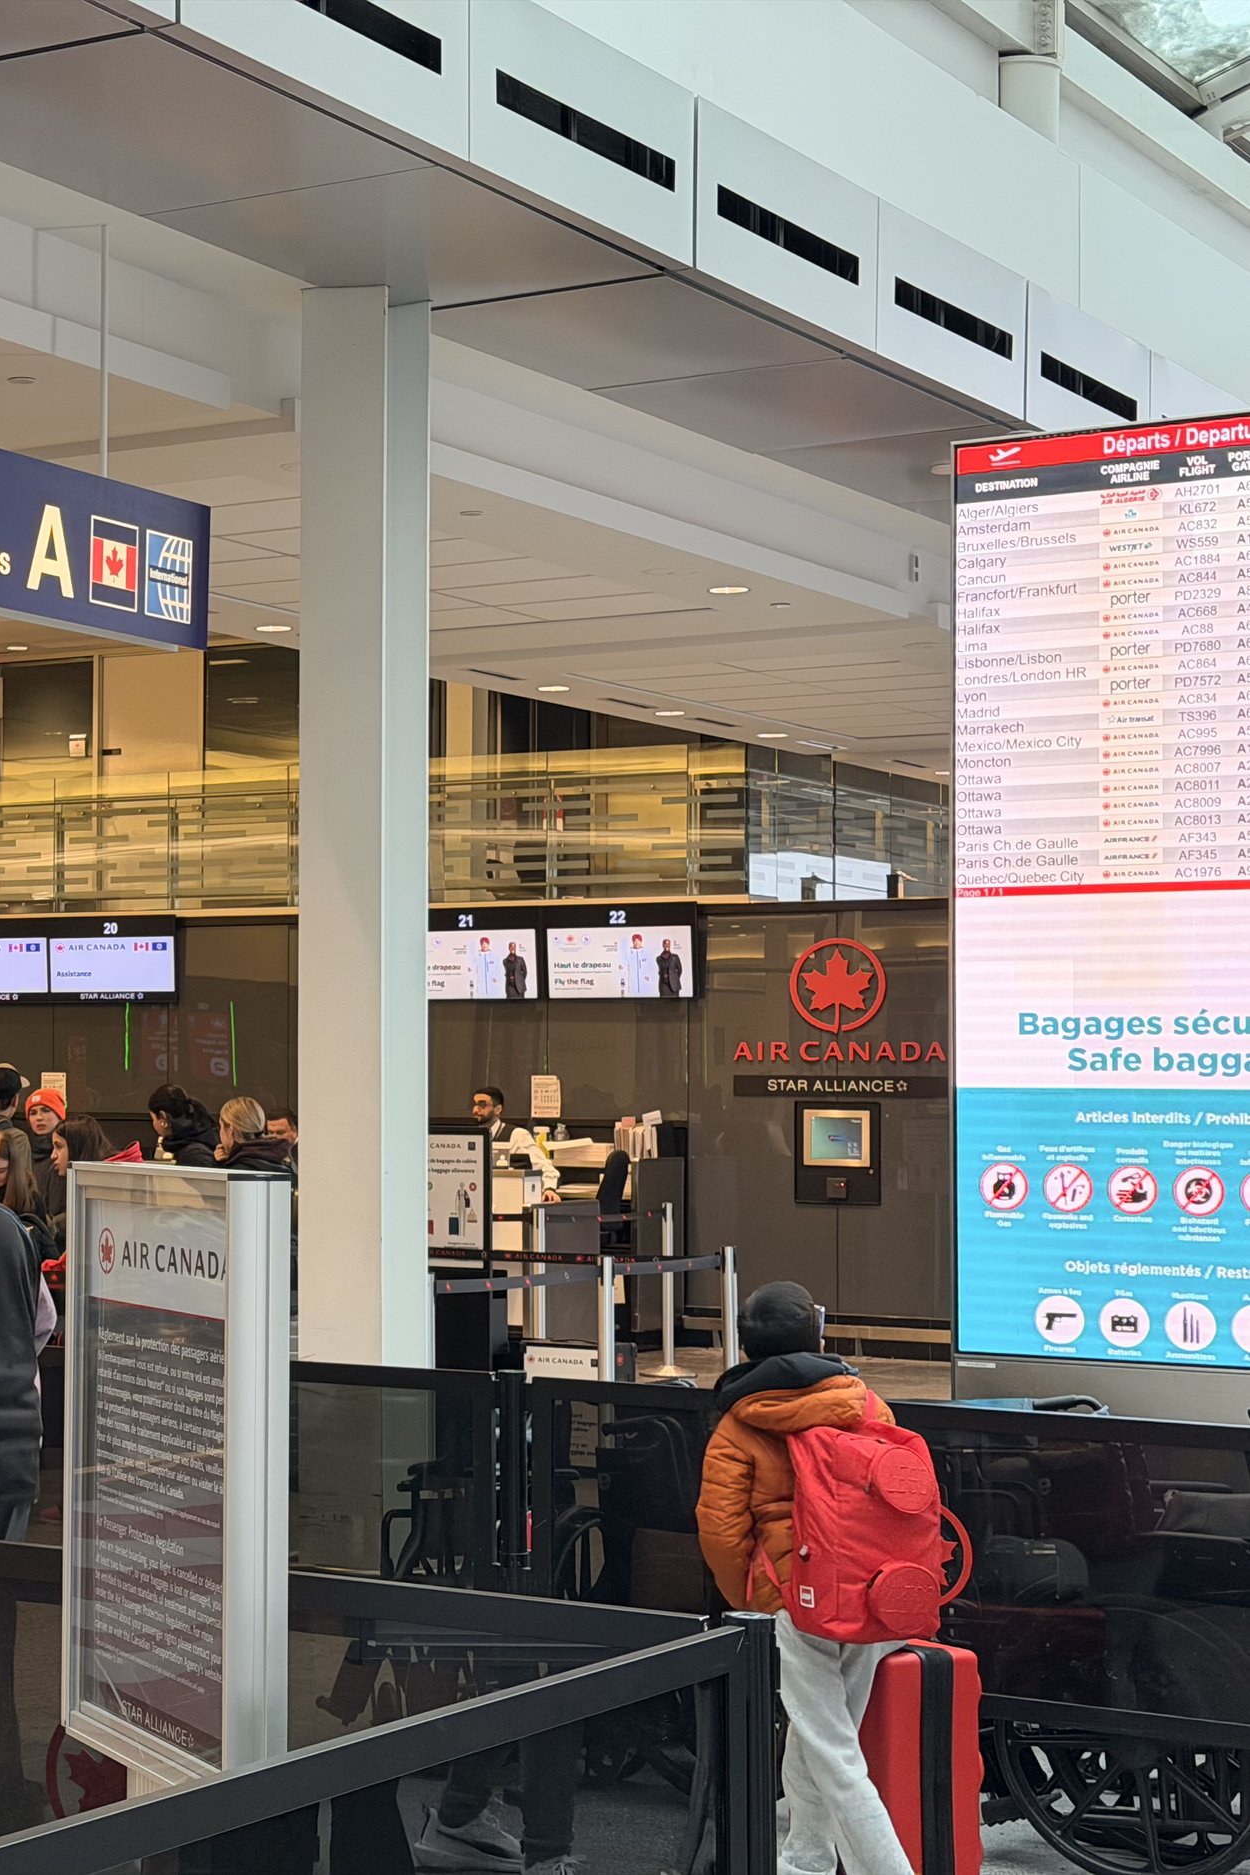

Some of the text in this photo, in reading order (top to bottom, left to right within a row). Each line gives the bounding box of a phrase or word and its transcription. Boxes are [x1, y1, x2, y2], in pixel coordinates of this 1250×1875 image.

[1103, 432, 1170, 456] Départs
[1186, 455, 1208, 466] VOL
[1100, 460, 1160, 475] COMPAGNIE
[1179, 464, 1216, 477] FLIGHT
[1110, 471, 1150, 484] AIRLINE
[975, 477, 1038, 493] DESTINATION
[1175, 484, 1220, 498] AH2701
[958, 503, 1039, 521] Alger/Algiers
[1179, 501, 1216, 515] KL672
[958, 521, 1031, 536] Amsterdam
[1178, 518, 1218, 532] AC832
[957, 532, 1077, 553] Bruxelles/Brussels
[1109, 542, 1143, 553] WESTJET
[1176, 536, 1219, 549] WS559
[26, 504, 74, 598] A
[957, 557, 1007, 570] Calgary
[1175, 553, 1220, 567] AC1884
[149, 568, 189, 588] International
[957, 573, 1006, 587] Cancun
[1178, 571, 1217, 584] AC844
[957, 583, 1077, 603] Francfort/Frankfurt
[1110, 591, 1151, 608] porter
[1174, 588, 1221, 601] PD2329
[957, 607, 1001, 619] Halifax
[1178, 605, 1218, 618] AC668
[957, 623, 1001, 636] Halifax
[1181, 623, 1214, 635] AC88
[957, 642, 988, 653] Lima
[1110, 643, 1151, 660] porter
[1174, 640, 1221, 653] PD7680
[957, 653, 1062, 670] Lisbonne/Lisbon
[1178, 657, 1217, 670] AC864
[957, 666, 1087, 686] Londres/London HR
[1174, 675, 1221, 688] PD7572
[1110, 677, 1151, 695] porter
[957, 692, 987, 704] Lyon
[1178, 692, 1217, 705] AC834
[957, 706, 1000, 719] Madrid
[1178, 710, 1217, 722] TS396
[957, 722, 1024, 736] Marrakech
[1178, 727, 1218, 740] AC995
[957, 735, 1082, 752] Mexico/Mexico City
[1174, 744, 1221, 757] AC7996
[957, 757, 1011, 769] Moncton
[1174, 762, 1221, 774] AC8007
[957, 774, 1002, 786] Ottawa
[1175, 779, 1219, 792] AC8011
[957, 791, 1002, 803] Ottawa
[1174, 797, 1221, 809] AC8009
[957, 808, 1002, 819] Ottawa
[1175, 814, 1221, 826] AC8013
[957, 824, 1002, 836] Ottawa
[1178, 832, 1217, 843] AF343
[957, 841, 989, 853] Paris
[1036, 838, 1079, 850] Gaulle
[957, 857, 989, 869] Paris
[1036, 854, 1079, 867] Gaulle
[1178, 849, 1217, 861] AF345
[957, 870, 1084, 886] Quebec/Quebec City
[1175, 866, 1221, 878] AC1976
[458, 914, 473, 928] 21
[609, 911, 626, 924] 22
[103, 922, 118, 935] 20
[87, 943, 126, 951] CANADA
[581, 961, 611, 970] drapeau
[554, 978, 565, 987] Fly
[581, 978, 594, 987] flag
[1018, 1008, 1250, 1040] Bagages sécu
[734, 1040, 947, 1062] AIR CANADA
[1067, 1047, 1142, 1072] Safe
[768, 1079, 895, 1093] STAR ALLIANCE
[1076, 1111, 1129, 1124] Articles
[121, 1240, 226, 1281] AIR CANAD
[1065, 1261, 1110, 1275] Objets
[1114, 1262, 1201, 1278] réglementés
[141, 1338, 170, 1353] protection
[170, 1341, 180, 1356] des
[181, 1346, 209, 1364] passagers
[552, 1357, 584, 1366] CANADA
[103, 1516, 128, 1539] Passenger
[128, 1525, 155, 1546] Protection
[156, 1534, 184, 1557] Regulation
[121, 1699, 188, 1748] STAR ALLIANCE
